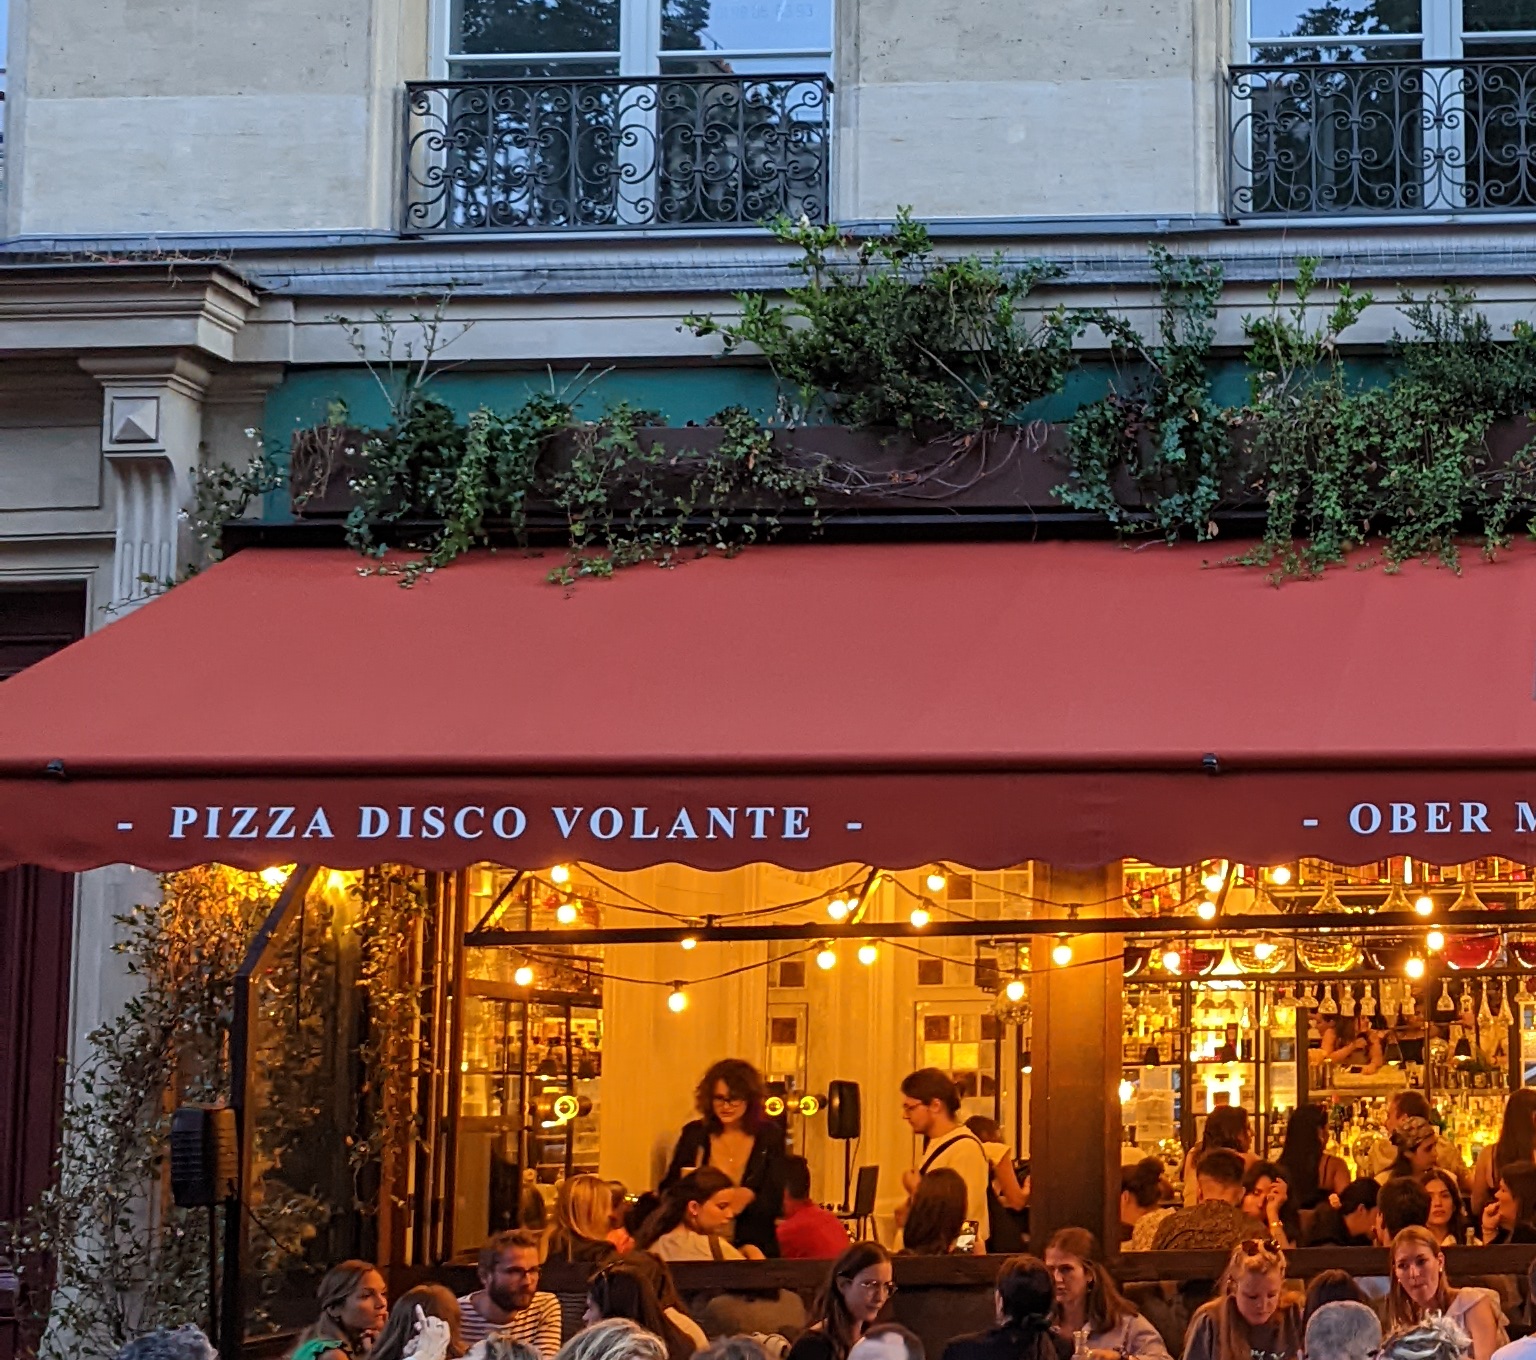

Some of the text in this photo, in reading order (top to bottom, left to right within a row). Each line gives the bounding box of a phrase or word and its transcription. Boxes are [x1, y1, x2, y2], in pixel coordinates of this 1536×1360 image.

[169, 806, 335, 839] PIZZA
[357, 806, 526, 839] DISCO
[551, 806, 810, 839] VOLANTE
[1349, 802, 1492, 834] OBER
